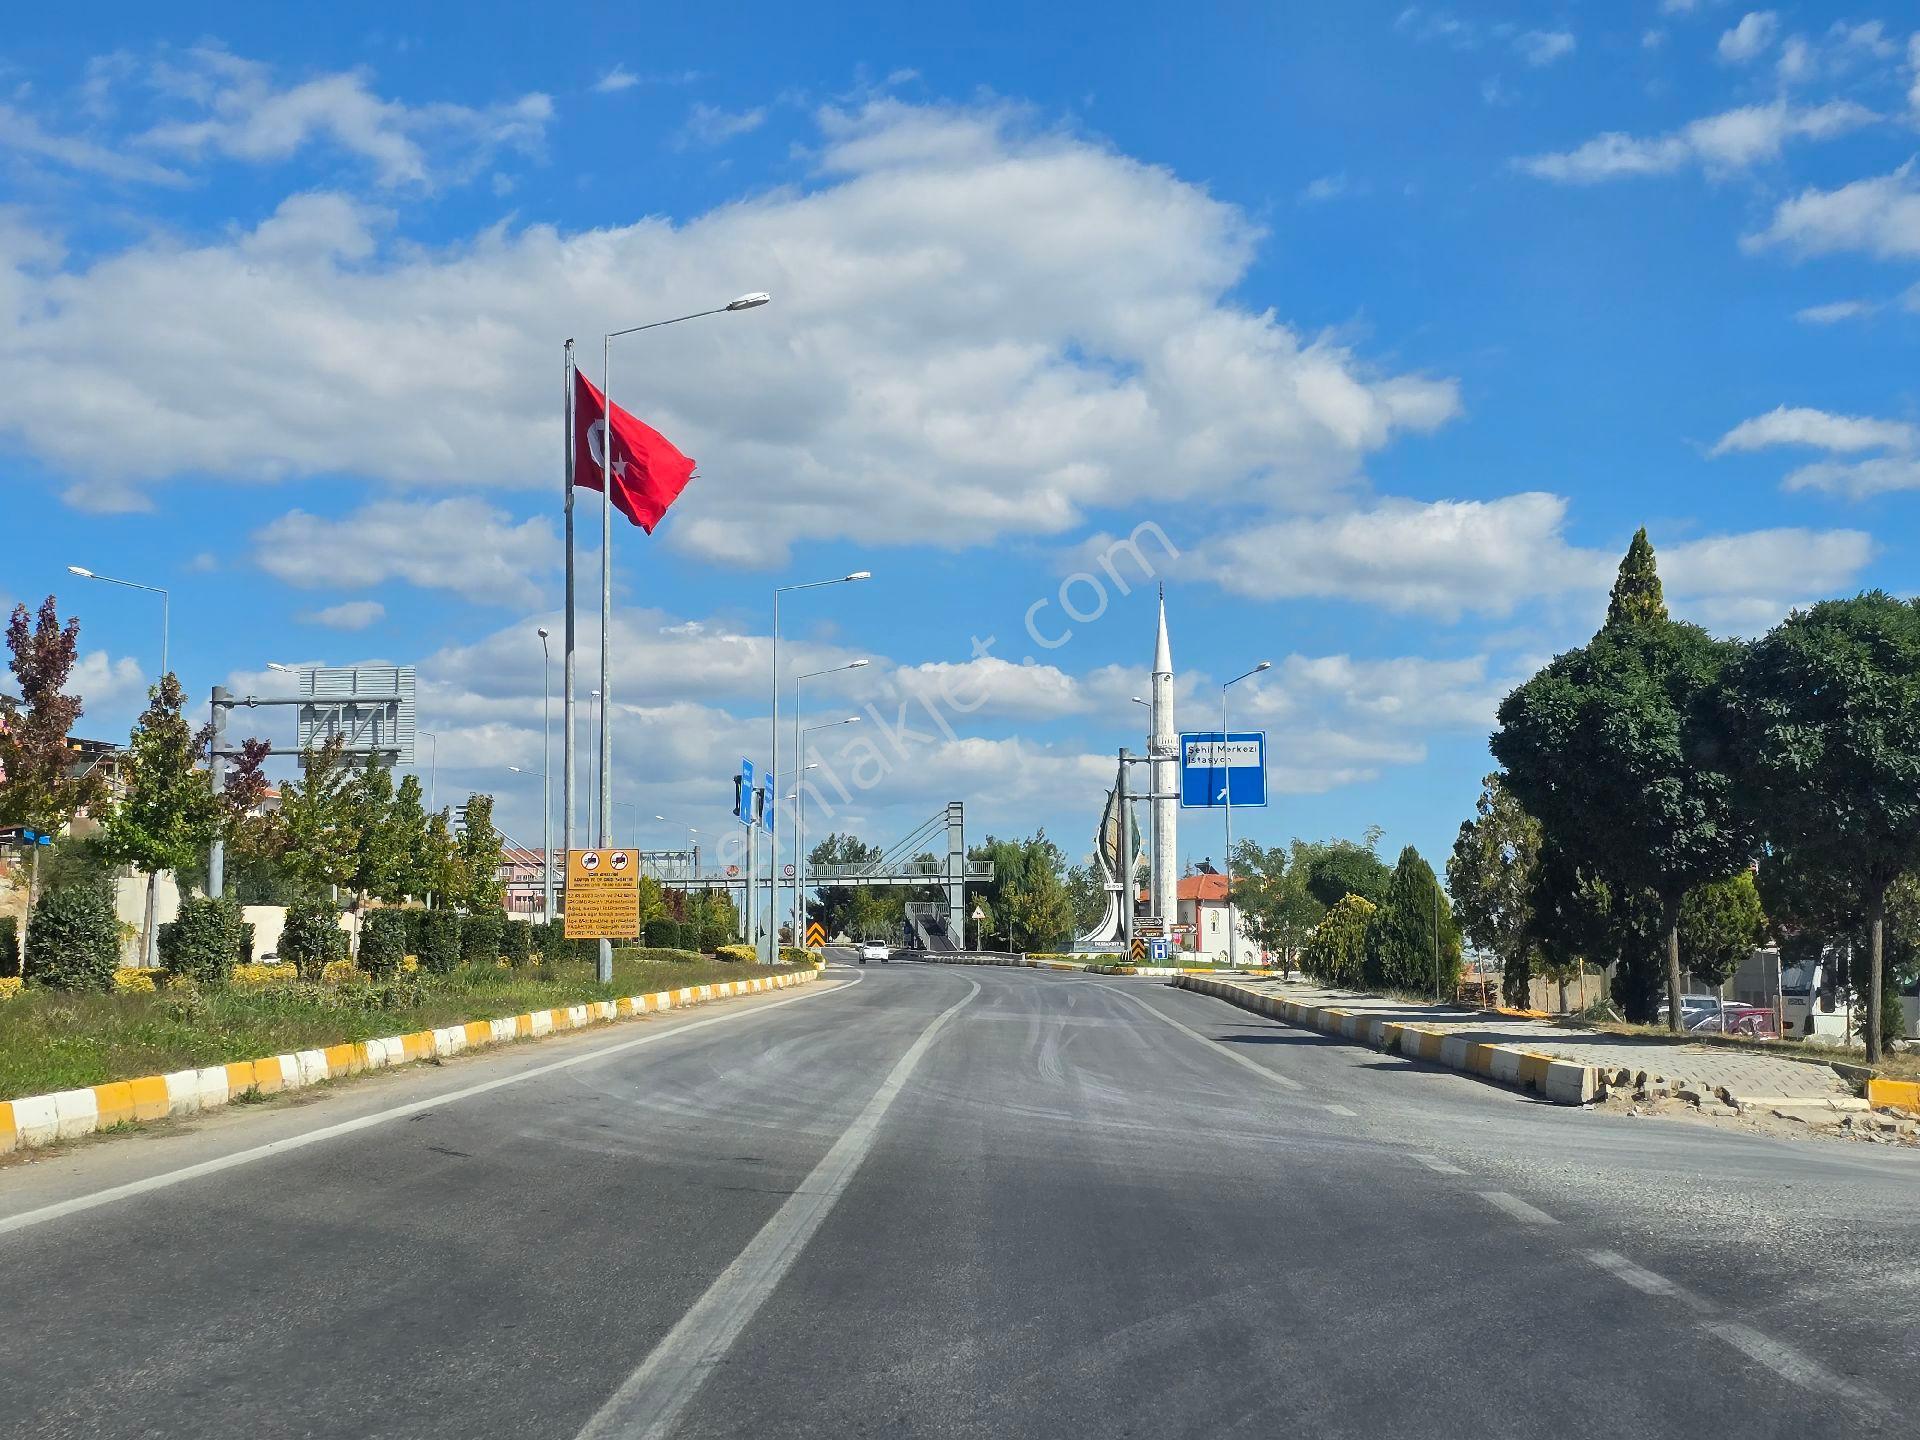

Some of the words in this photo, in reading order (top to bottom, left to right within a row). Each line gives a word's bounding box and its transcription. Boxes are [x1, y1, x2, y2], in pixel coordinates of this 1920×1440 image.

[1188, 746, 1213, 755] Şehir
[1217, 745, 1257, 753] Merkezi
[1154, 944, 1166, 958] H
